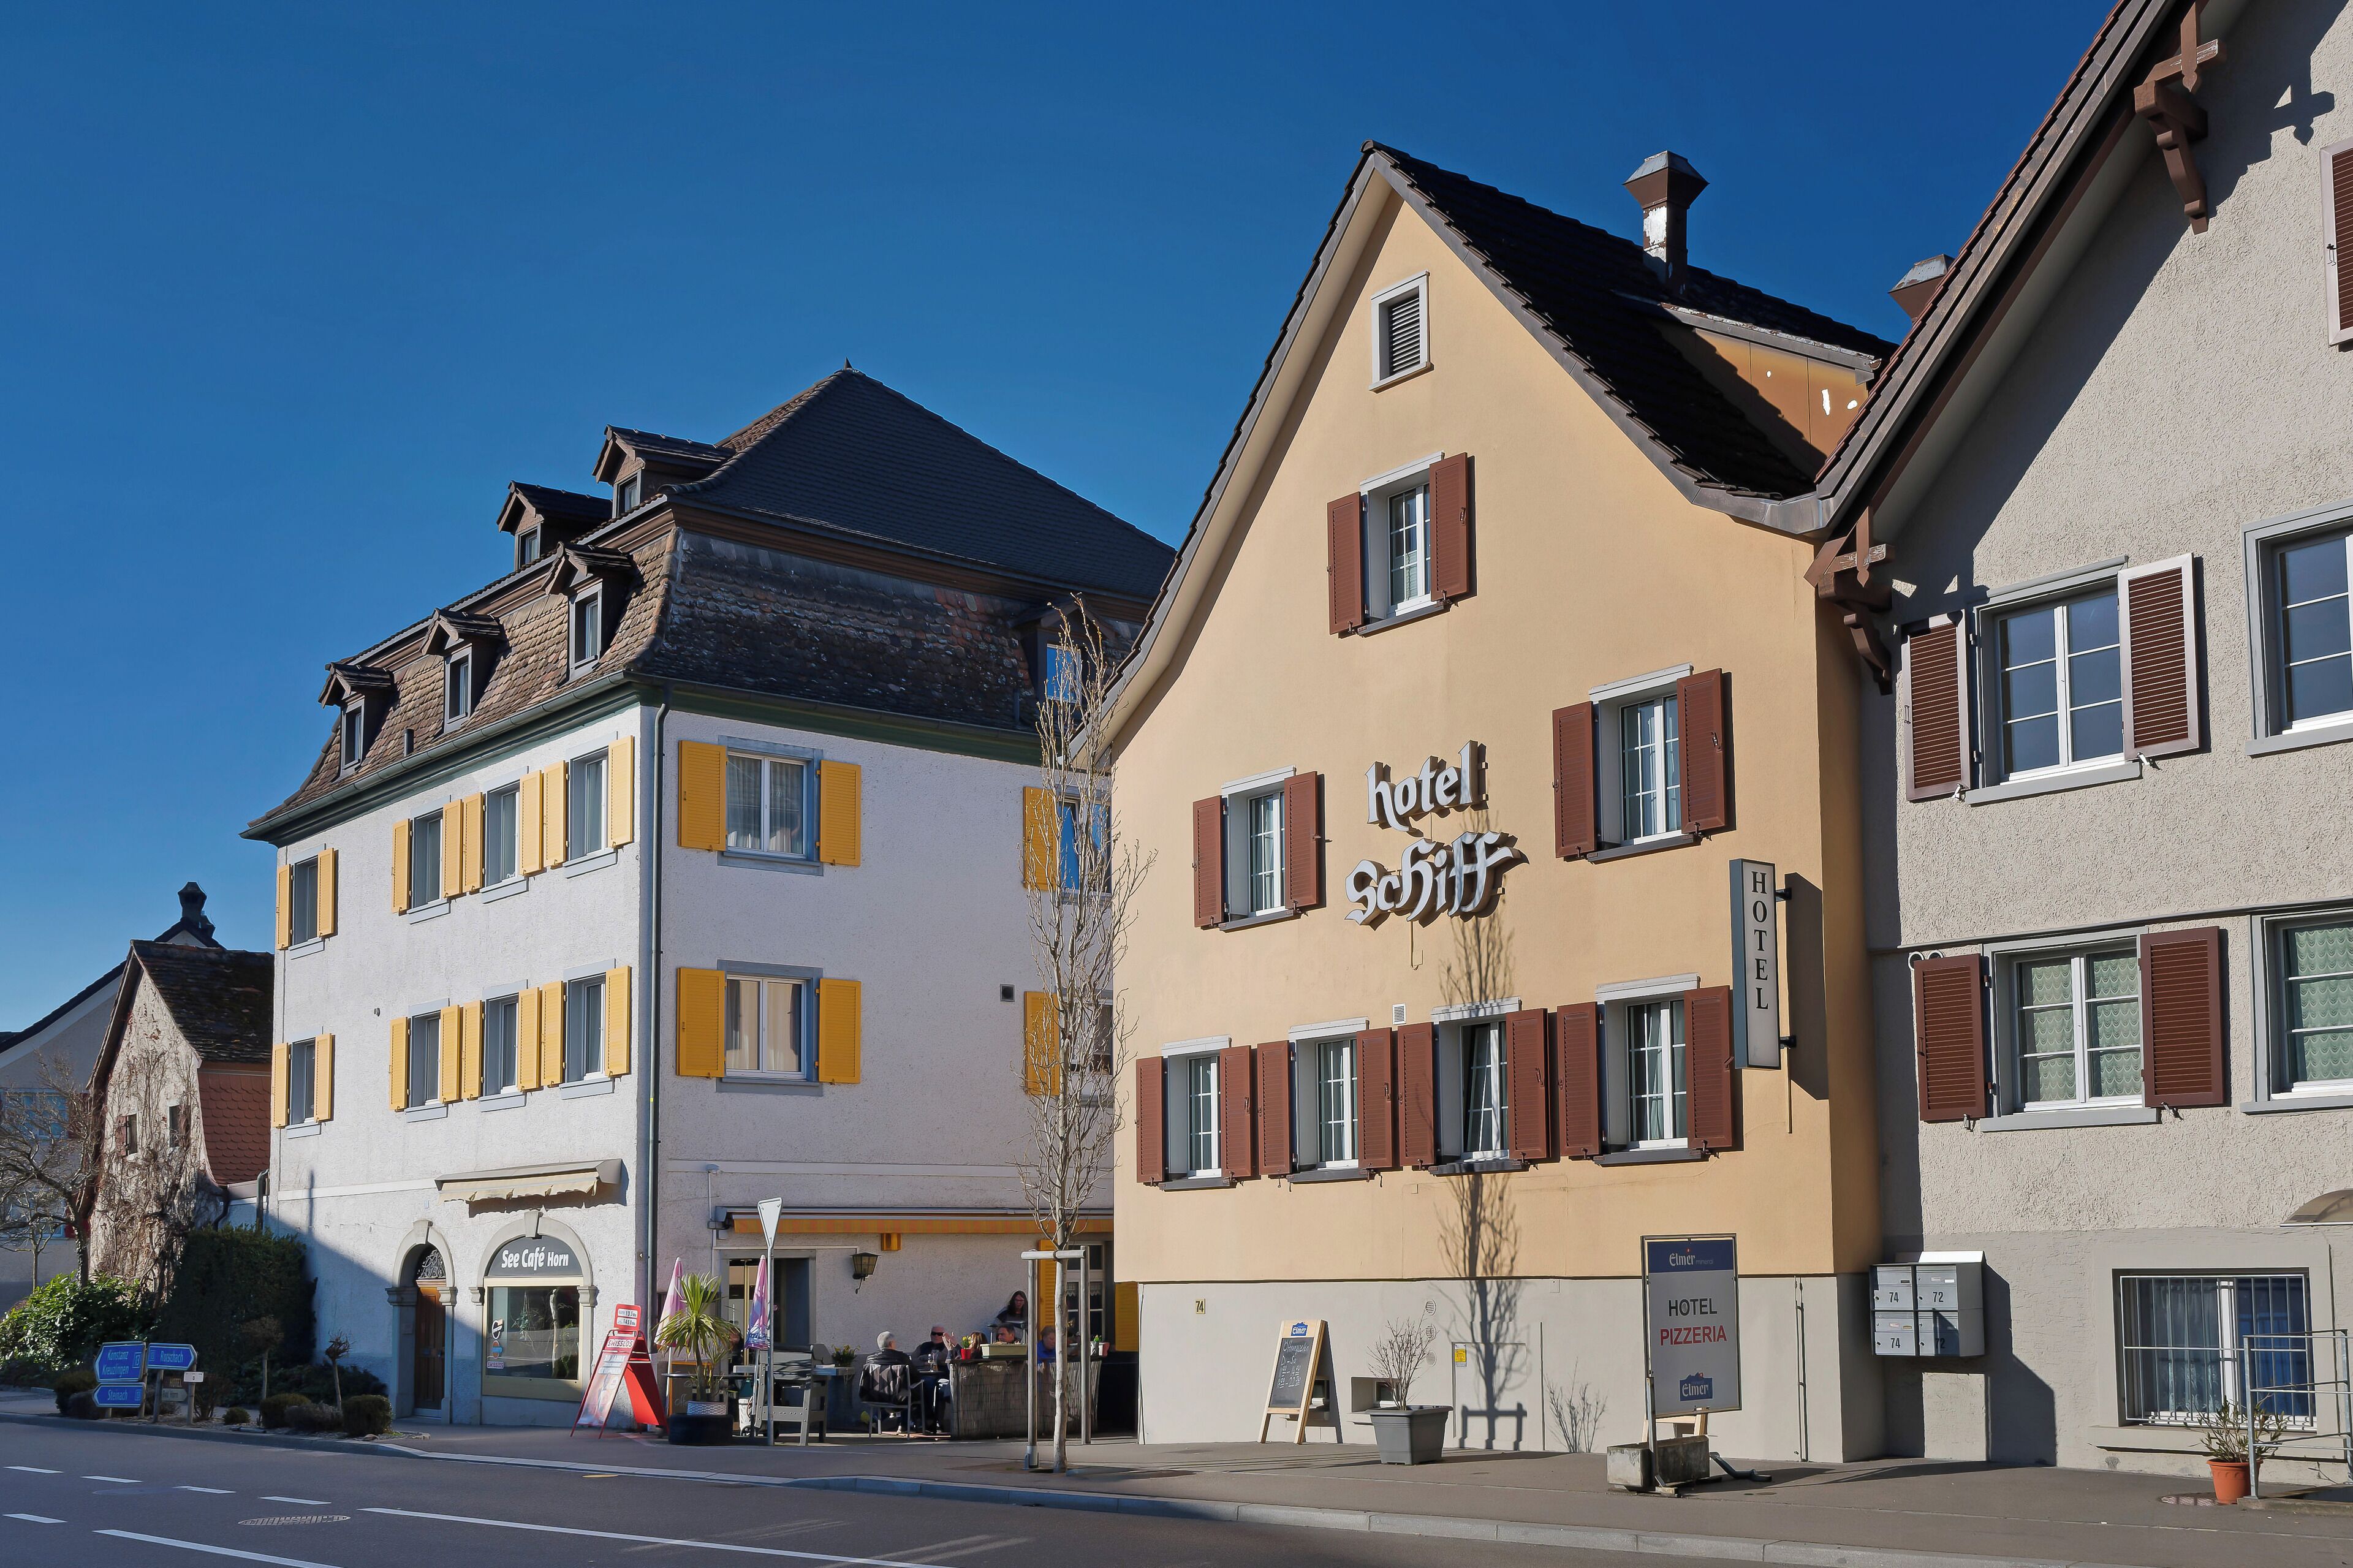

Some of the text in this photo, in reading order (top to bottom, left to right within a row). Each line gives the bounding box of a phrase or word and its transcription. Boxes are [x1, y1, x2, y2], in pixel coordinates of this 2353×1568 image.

[1365, 740, 1478, 832] hotel
[1751, 871, 1768, 1010] HOTEL
[501, 1246, 569, 1271] See Café Horn
[1669, 1252, 1696, 1267] Elmer
[1889, 1292, 1899, 1303] 74
[1933, 1291, 1944, 1303] 72
[1195, 1300, 1204, 1312] 74
[1668, 1298, 1718, 1317] HOTEL
[1292, 1326, 1306, 1335] Elmer
[1660, 1325, 1727, 1346] PIZZERIA
[1890, 1338, 1900, 1349] 74
[1936, 1338, 1946, 1349] 72
[107, 1350, 129, 1360] Konstanz
[160, 1350, 184, 1363] Rorschach
[102, 1365, 129, 1377] Kreuzlingen
[169, 1378, 182, 1387] HOTEL
[107, 1389, 127, 1401] Steinach
[1682, 1383, 1709, 1396] Elmer
